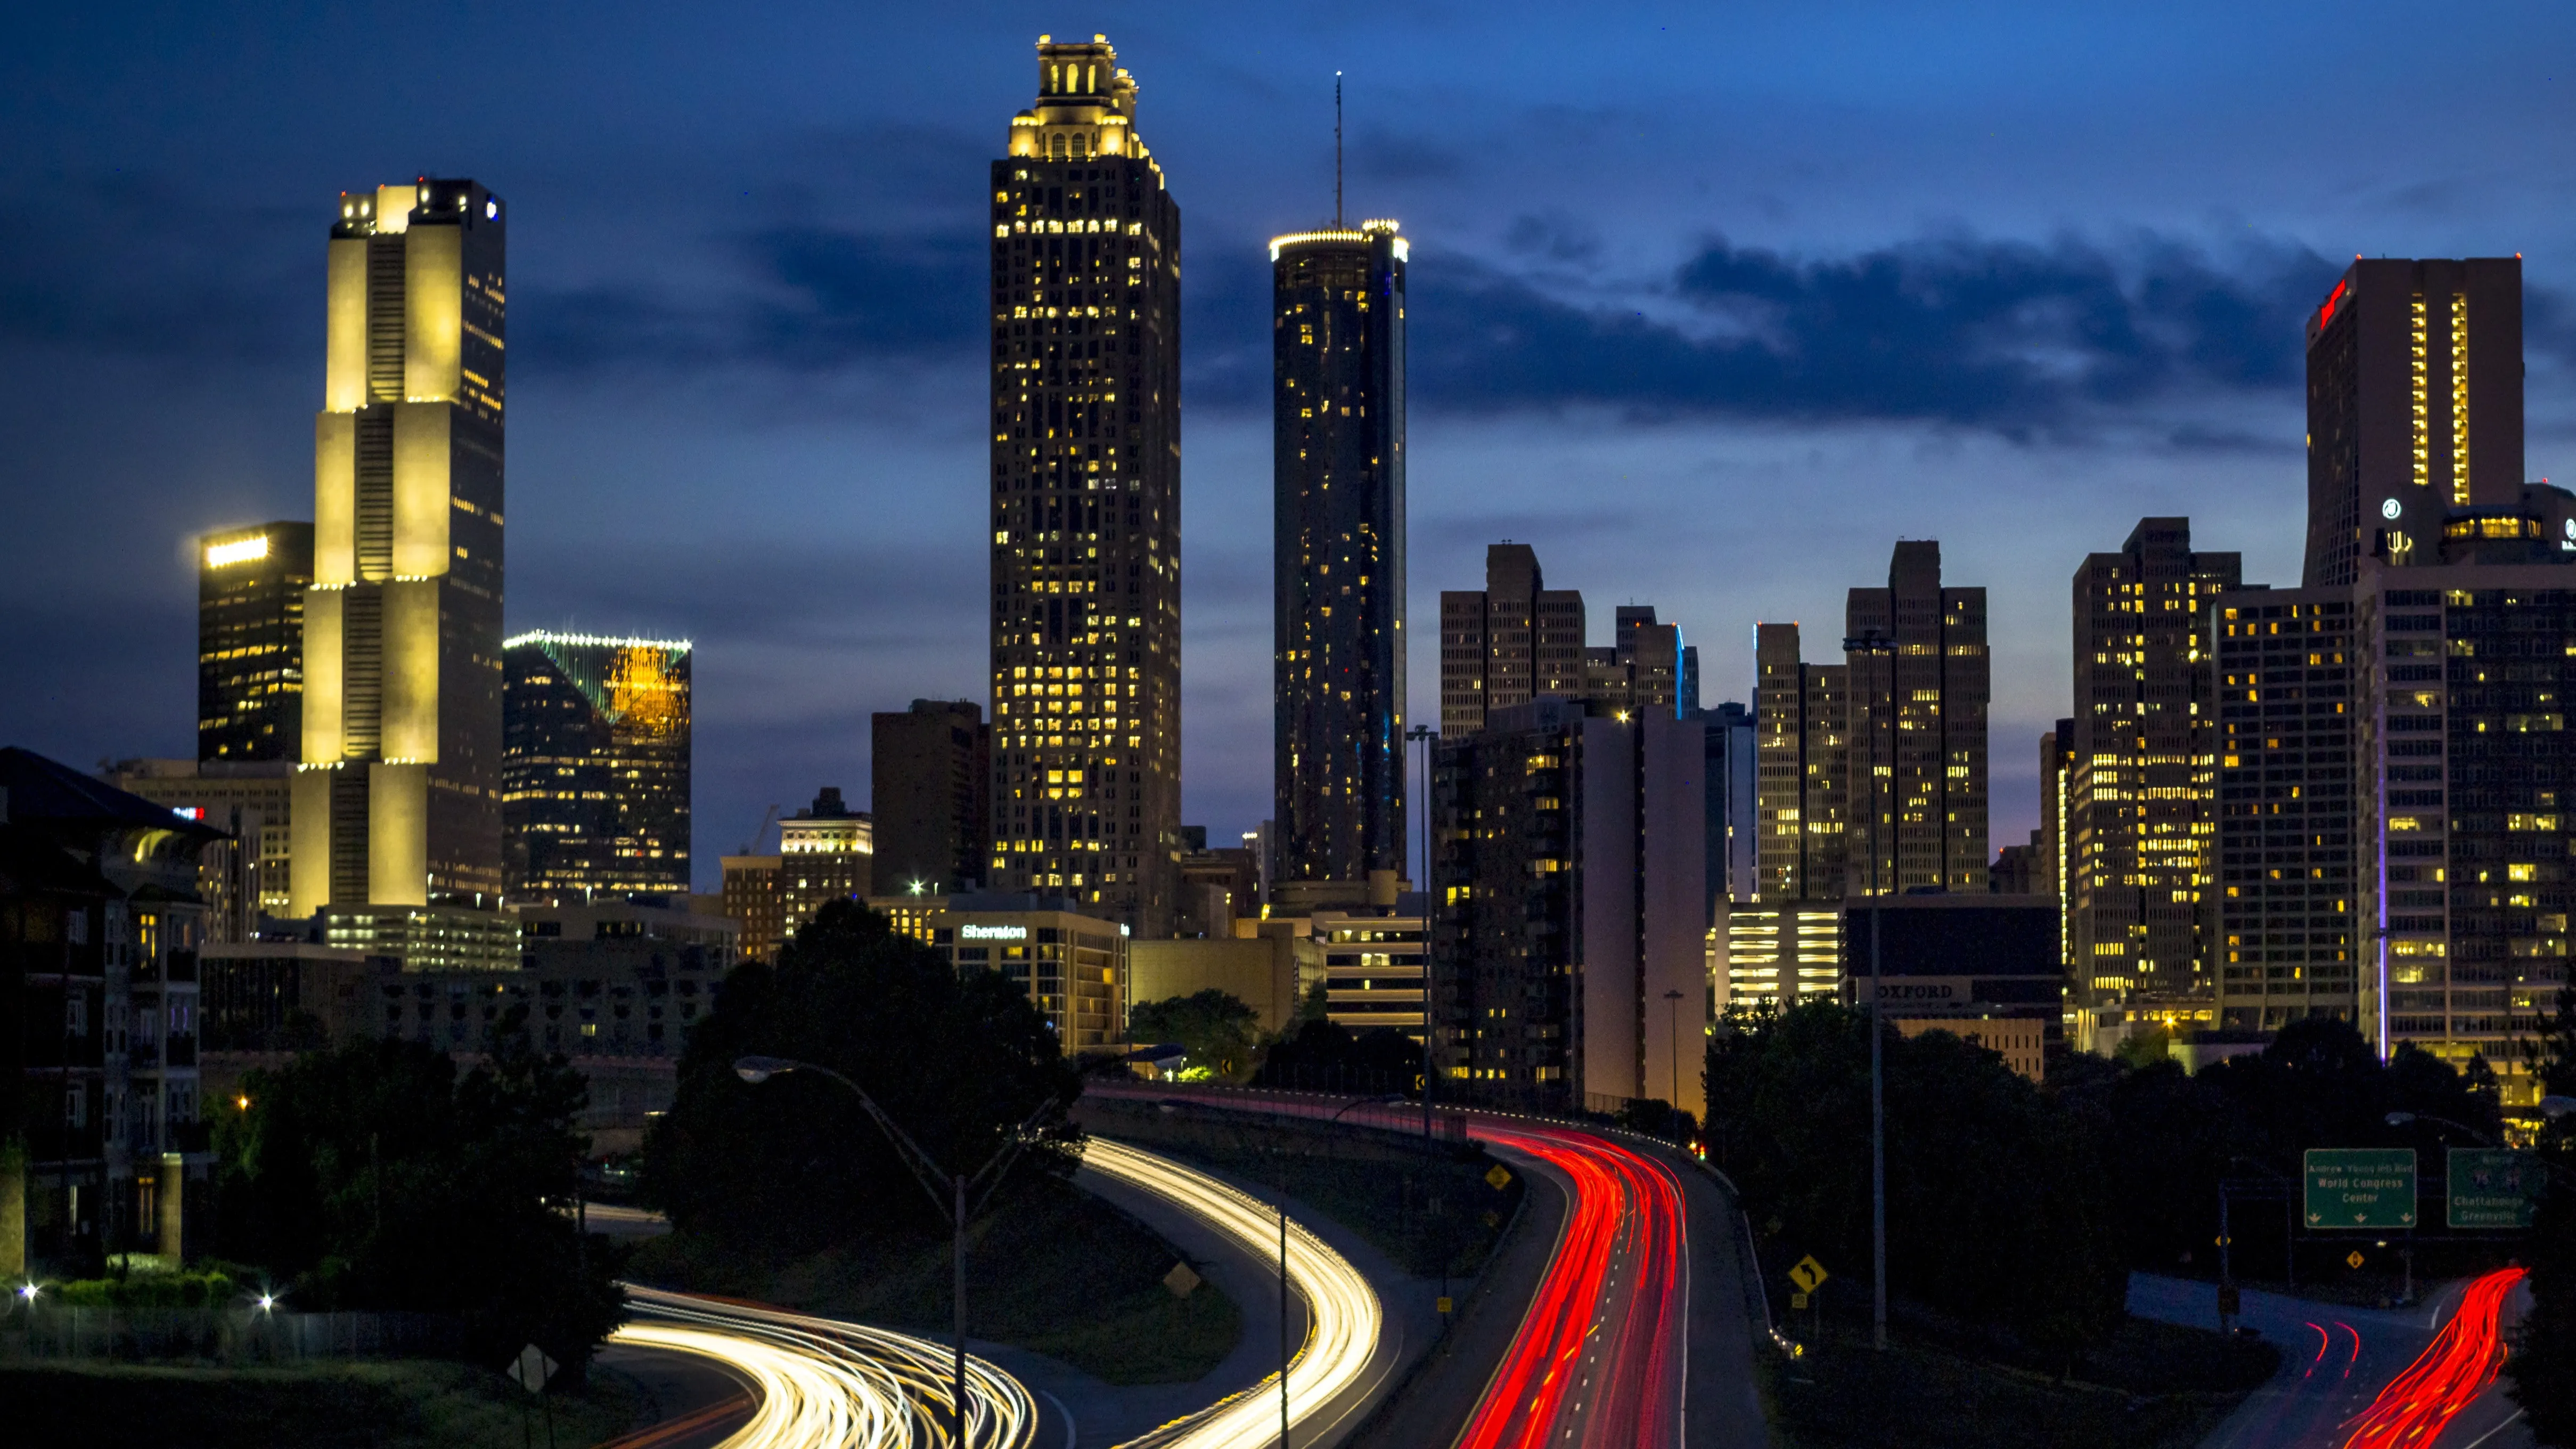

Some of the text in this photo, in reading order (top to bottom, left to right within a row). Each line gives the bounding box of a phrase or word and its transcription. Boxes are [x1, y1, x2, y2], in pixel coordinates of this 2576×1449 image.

[962, 924, 1027, 939] Sheraton
[1876, 985, 1952, 999] OXFORD
[2318, 1177, 2403, 1190] World Congress
[2342, 1193, 2379, 1203] Center
